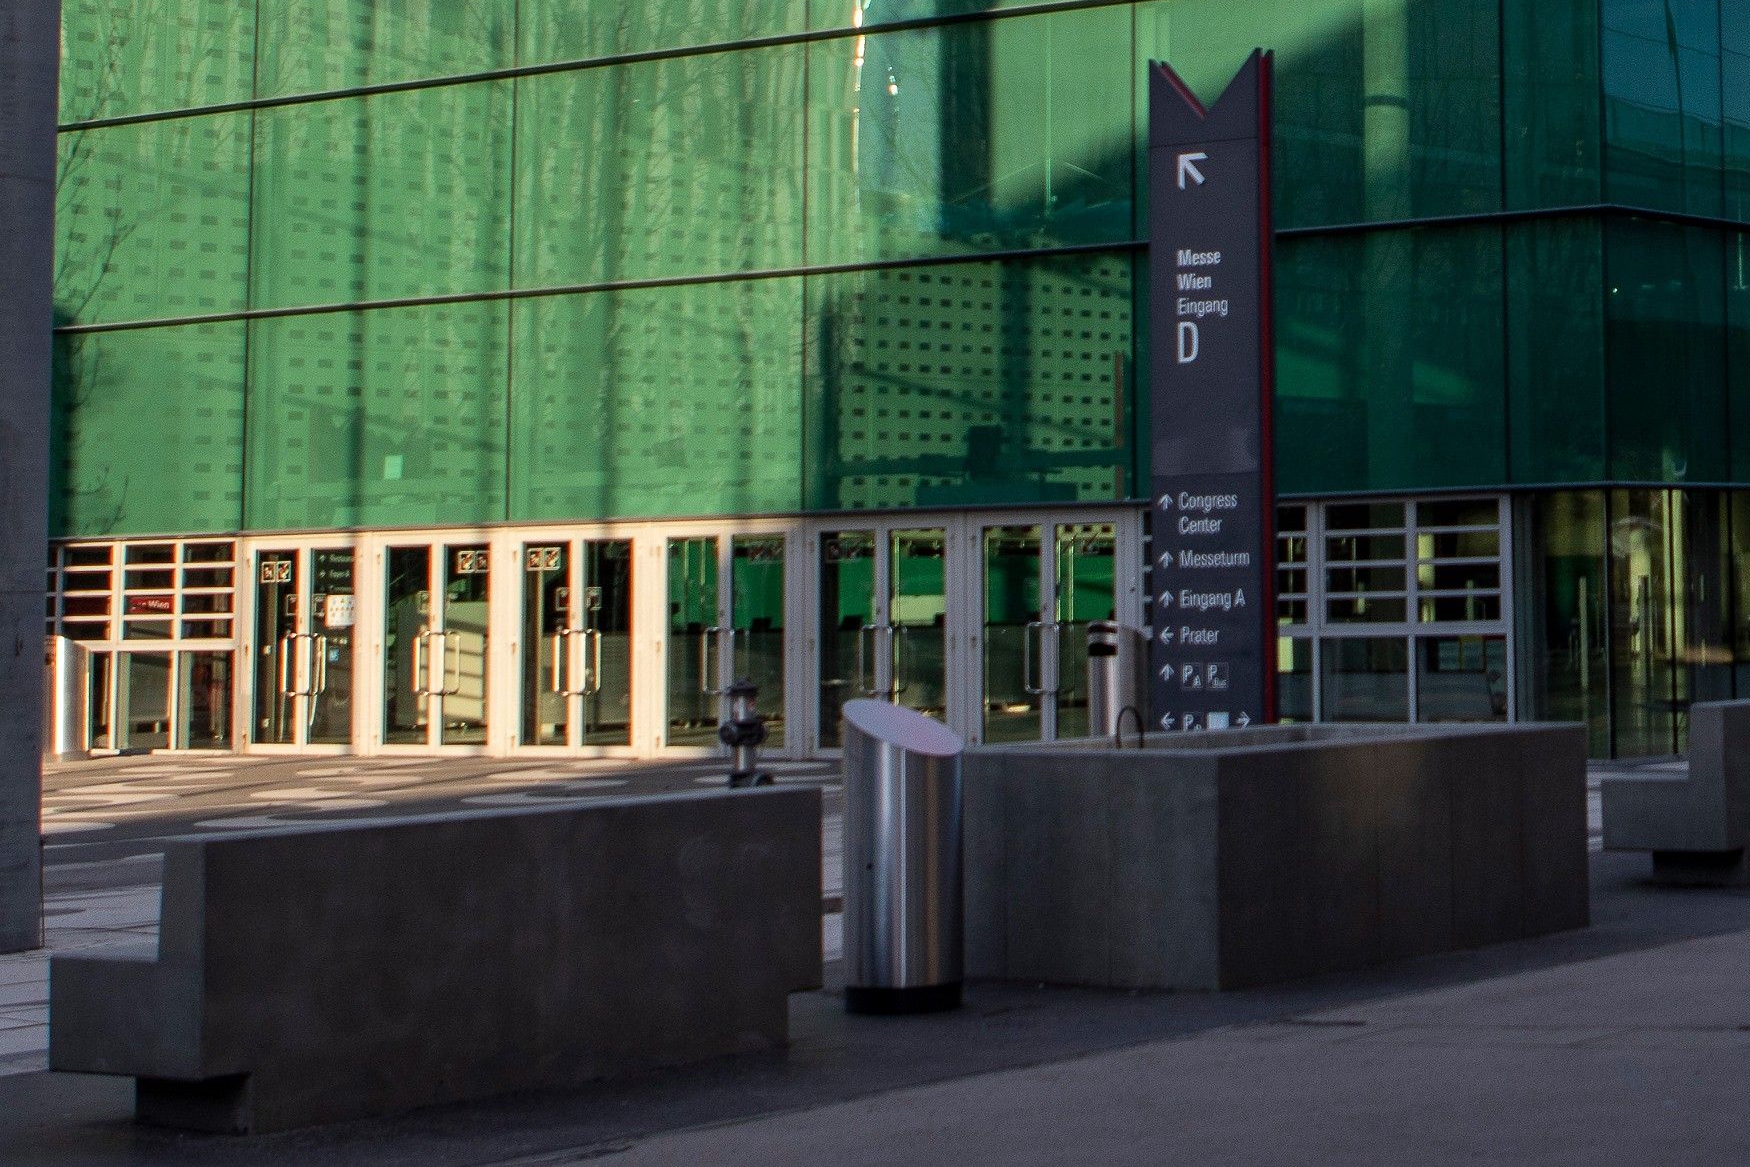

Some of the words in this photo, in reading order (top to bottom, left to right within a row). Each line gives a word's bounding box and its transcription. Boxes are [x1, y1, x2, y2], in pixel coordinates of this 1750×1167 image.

[1177, 248, 1221, 266] Messe
[1177, 273, 1212, 290] Wien
[1177, 297, 1229, 317] Eingang
[1177, 321, 1200, 364] D
[1179, 492, 1237, 514] Congress
[1179, 516, 1222, 534] Center
[1179, 550, 1250, 569] Messeturm
[1180, 589, 1232, 611] Eingang
[1234, 588, 1246, 608] A
[1180, 626, 1220, 645] Prater
